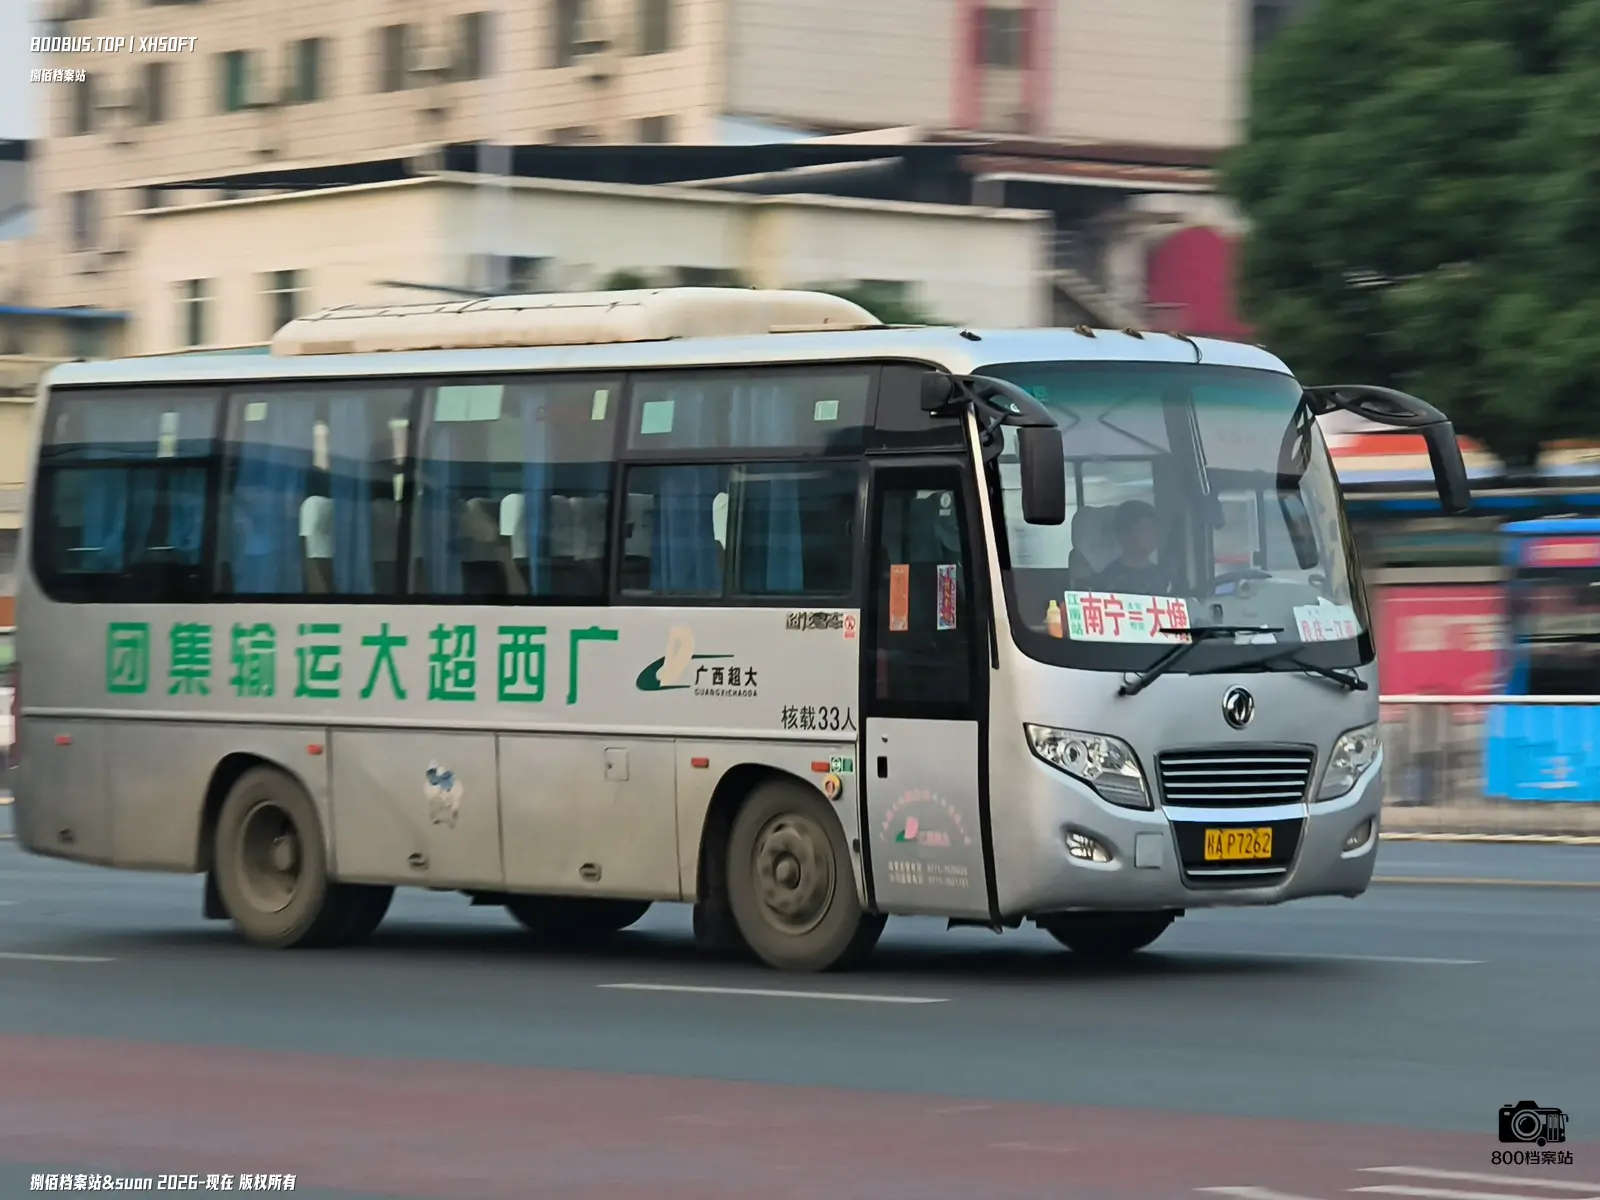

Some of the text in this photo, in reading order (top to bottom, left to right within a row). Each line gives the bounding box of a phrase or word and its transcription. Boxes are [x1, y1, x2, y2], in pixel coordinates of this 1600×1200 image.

[695, 665, 757, 687] 广西超大
[781, 704, 857, 731] 核载33人
